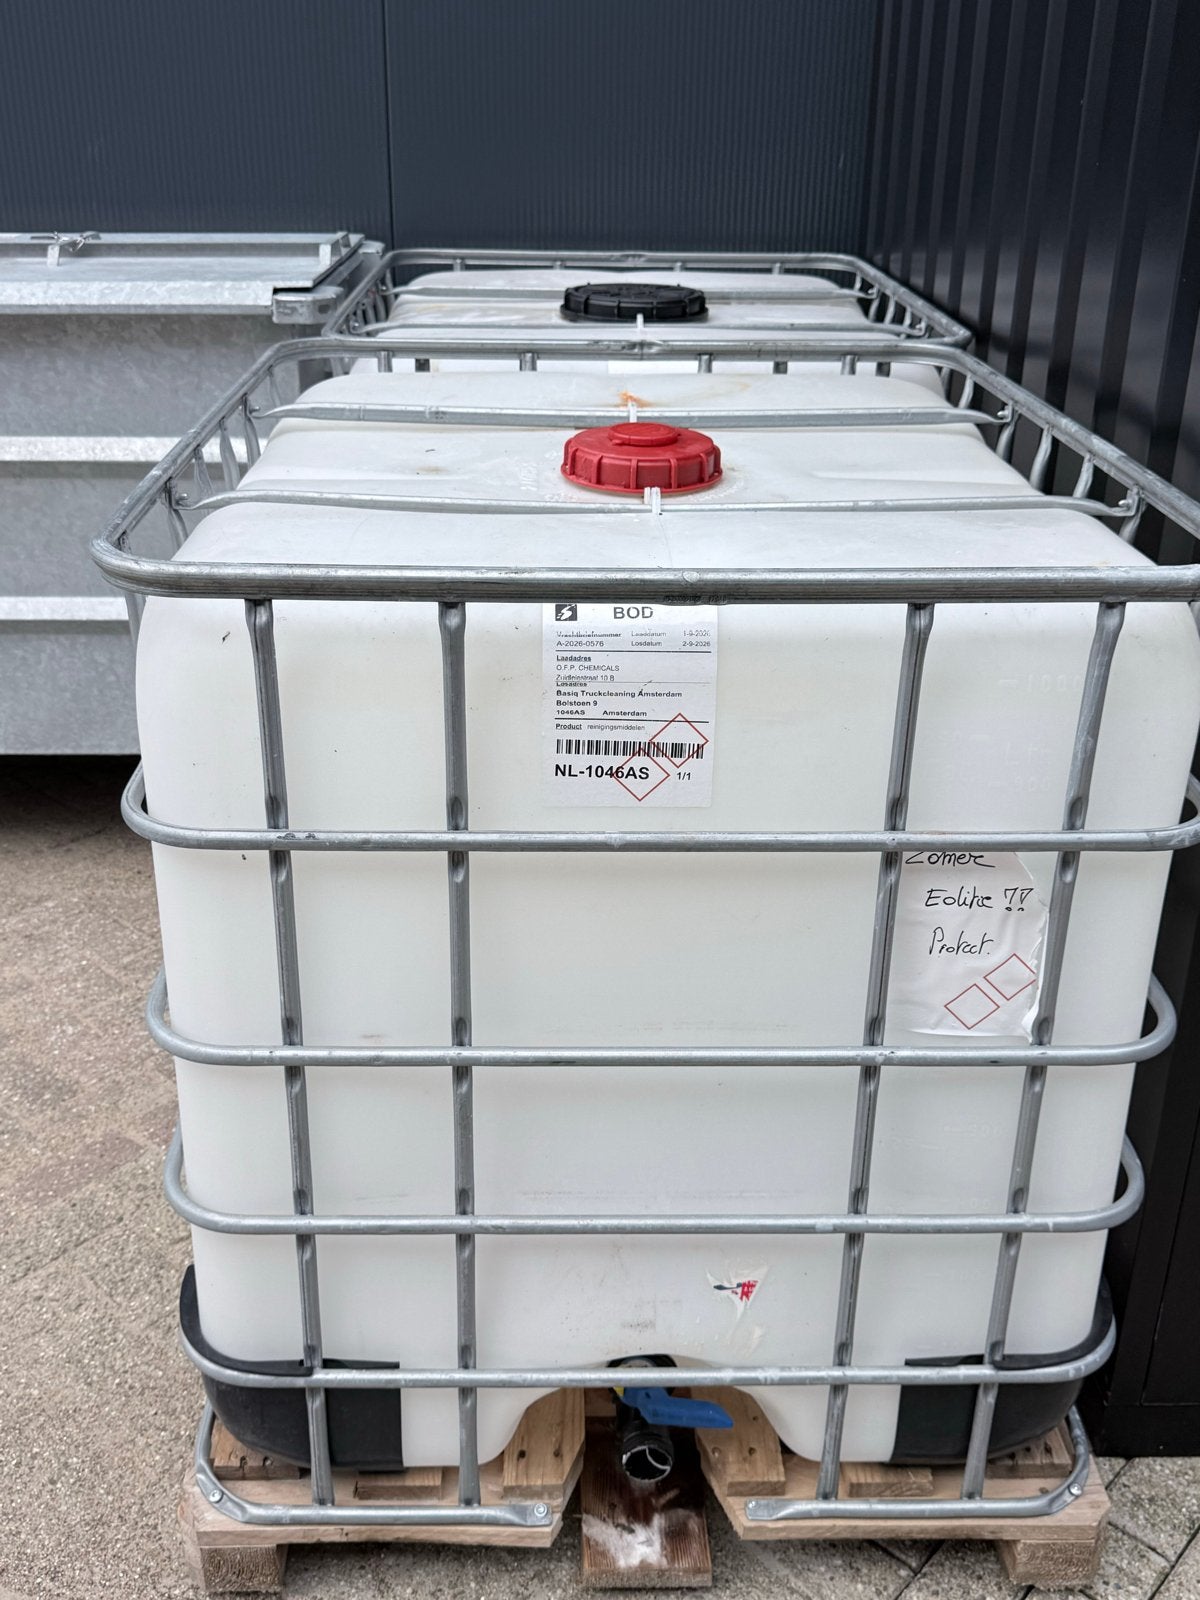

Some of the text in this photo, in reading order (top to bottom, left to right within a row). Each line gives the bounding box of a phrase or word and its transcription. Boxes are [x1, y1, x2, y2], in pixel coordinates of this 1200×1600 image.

[613, 606, 654, 619] BOD
[556, 689, 683, 698] Basiq Truckcleaning Amsterdam
[587, 724, 645, 732] reinigingsmiddelen
[554, 764, 691, 781] NL-1046AS 1/1
